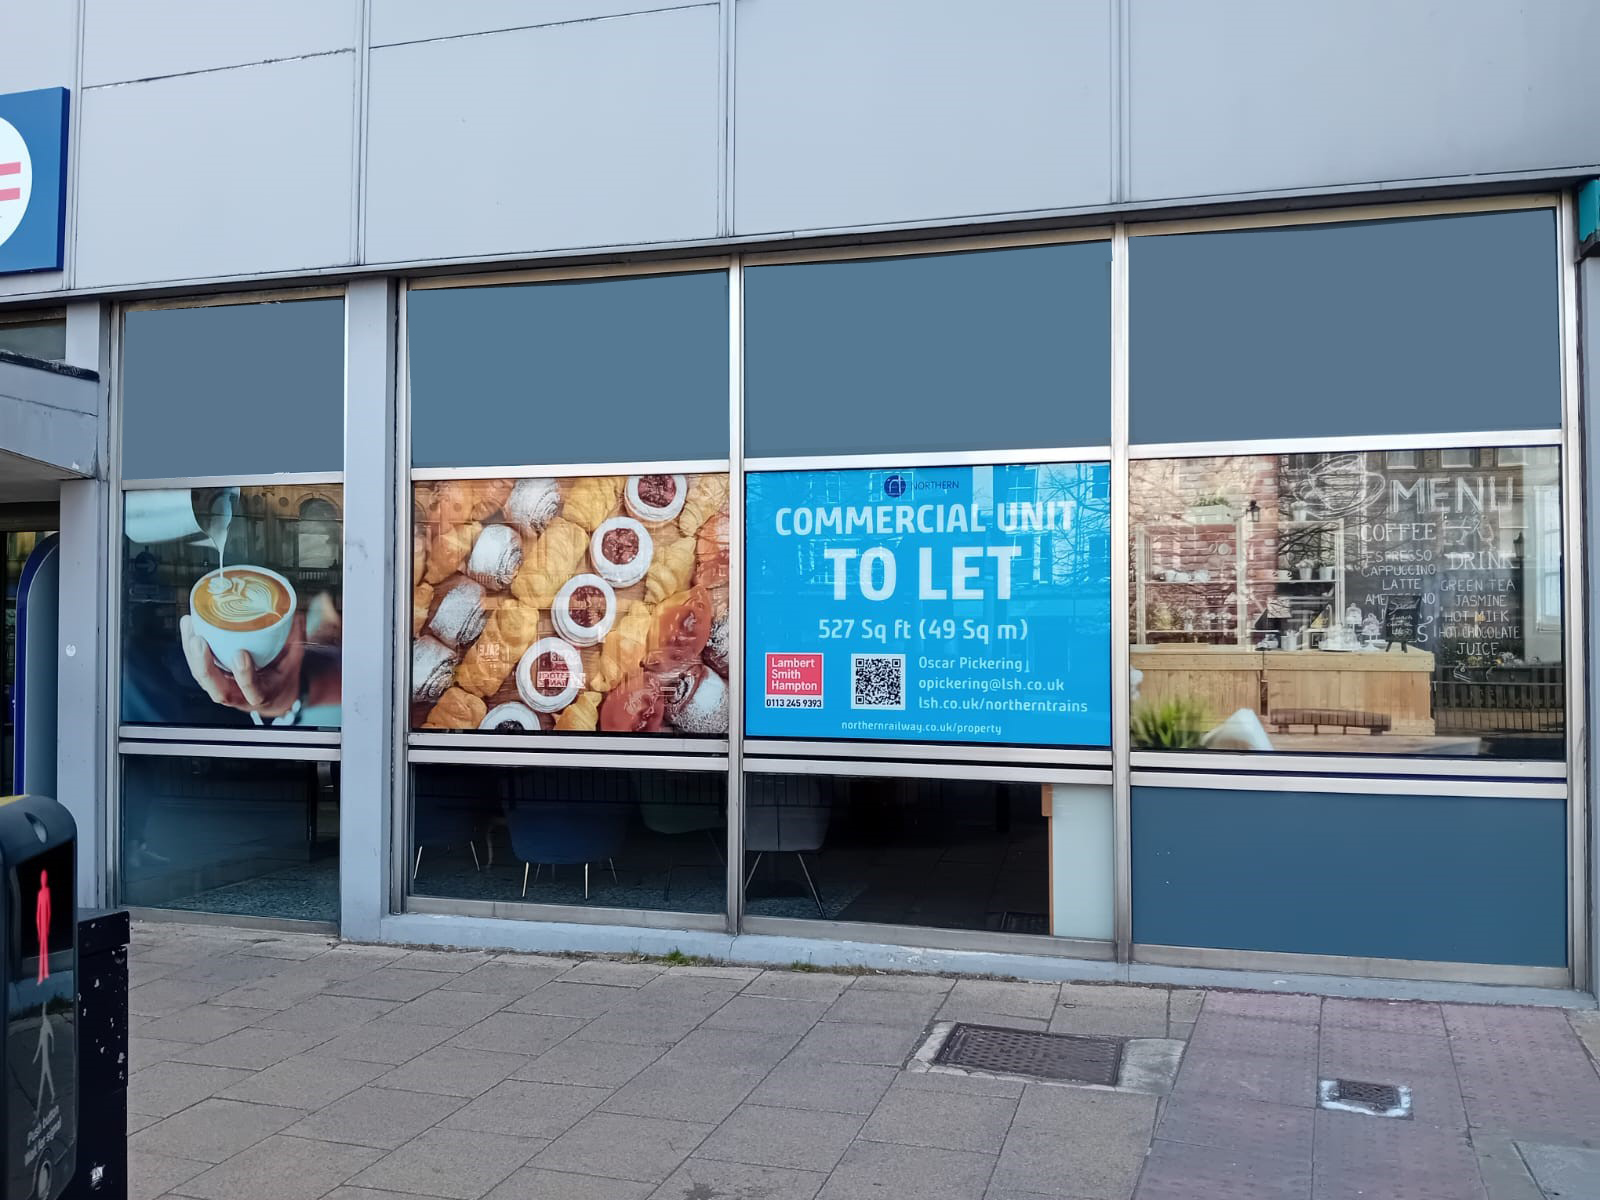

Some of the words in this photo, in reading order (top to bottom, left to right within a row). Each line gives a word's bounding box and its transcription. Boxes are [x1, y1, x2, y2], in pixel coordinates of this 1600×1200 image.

[911, 479, 960, 490] NORTHERN
[1390, 476, 1513, 514] MENU
[775, 503, 987, 536] COMMERCIAL
[997, 500, 1077, 532] UNIT
[1361, 522, 1436, 542] COFFEE
[1365, 550, 1432, 564] ESPRESSO
[824, 546, 897, 601] TO
[919, 546, 1022, 600] LET
[1361, 564, 1436, 578] CAPPUCCINO
[1382, 578, 1422, 591] LATTE
[1440, 579, 1484, 592] GREEN
[1489, 578, 1516, 592] TEA
[1455, 594, 1507, 607] JASMINE
[1444, 610, 1469, 622] HOT
[818, 619, 855, 639] 527
[861, 619, 887, 644] Sq
[894, 619, 911, 639] ft
[919, 618, 956, 640] (49
[962, 619, 989, 645] Sq
[997, 618, 1028, 640] m)
[1439, 626, 1457, 639] HOT
[1462, 626, 1520, 639] CHOCOLATE
[1456, 642, 1499, 655] JUICE
[771, 657, 815, 668] Lambert
[918, 656, 956, 669] Oscar
[959, 656, 1023, 672] Pickering
[771, 669, 801, 679] Smith
[771, 680, 818, 693] Hampton
[918, 677, 1065, 693] opickering@lsh.co.uk
[766, 699, 785, 707] 0113
[786, 699, 801, 708] 245
[802, 699, 822, 708] 9393
[918, 696, 1088, 713] lsh.co.uk/northerntrains
[841, 720, 1002, 736] northernrailway.co.uk/property
